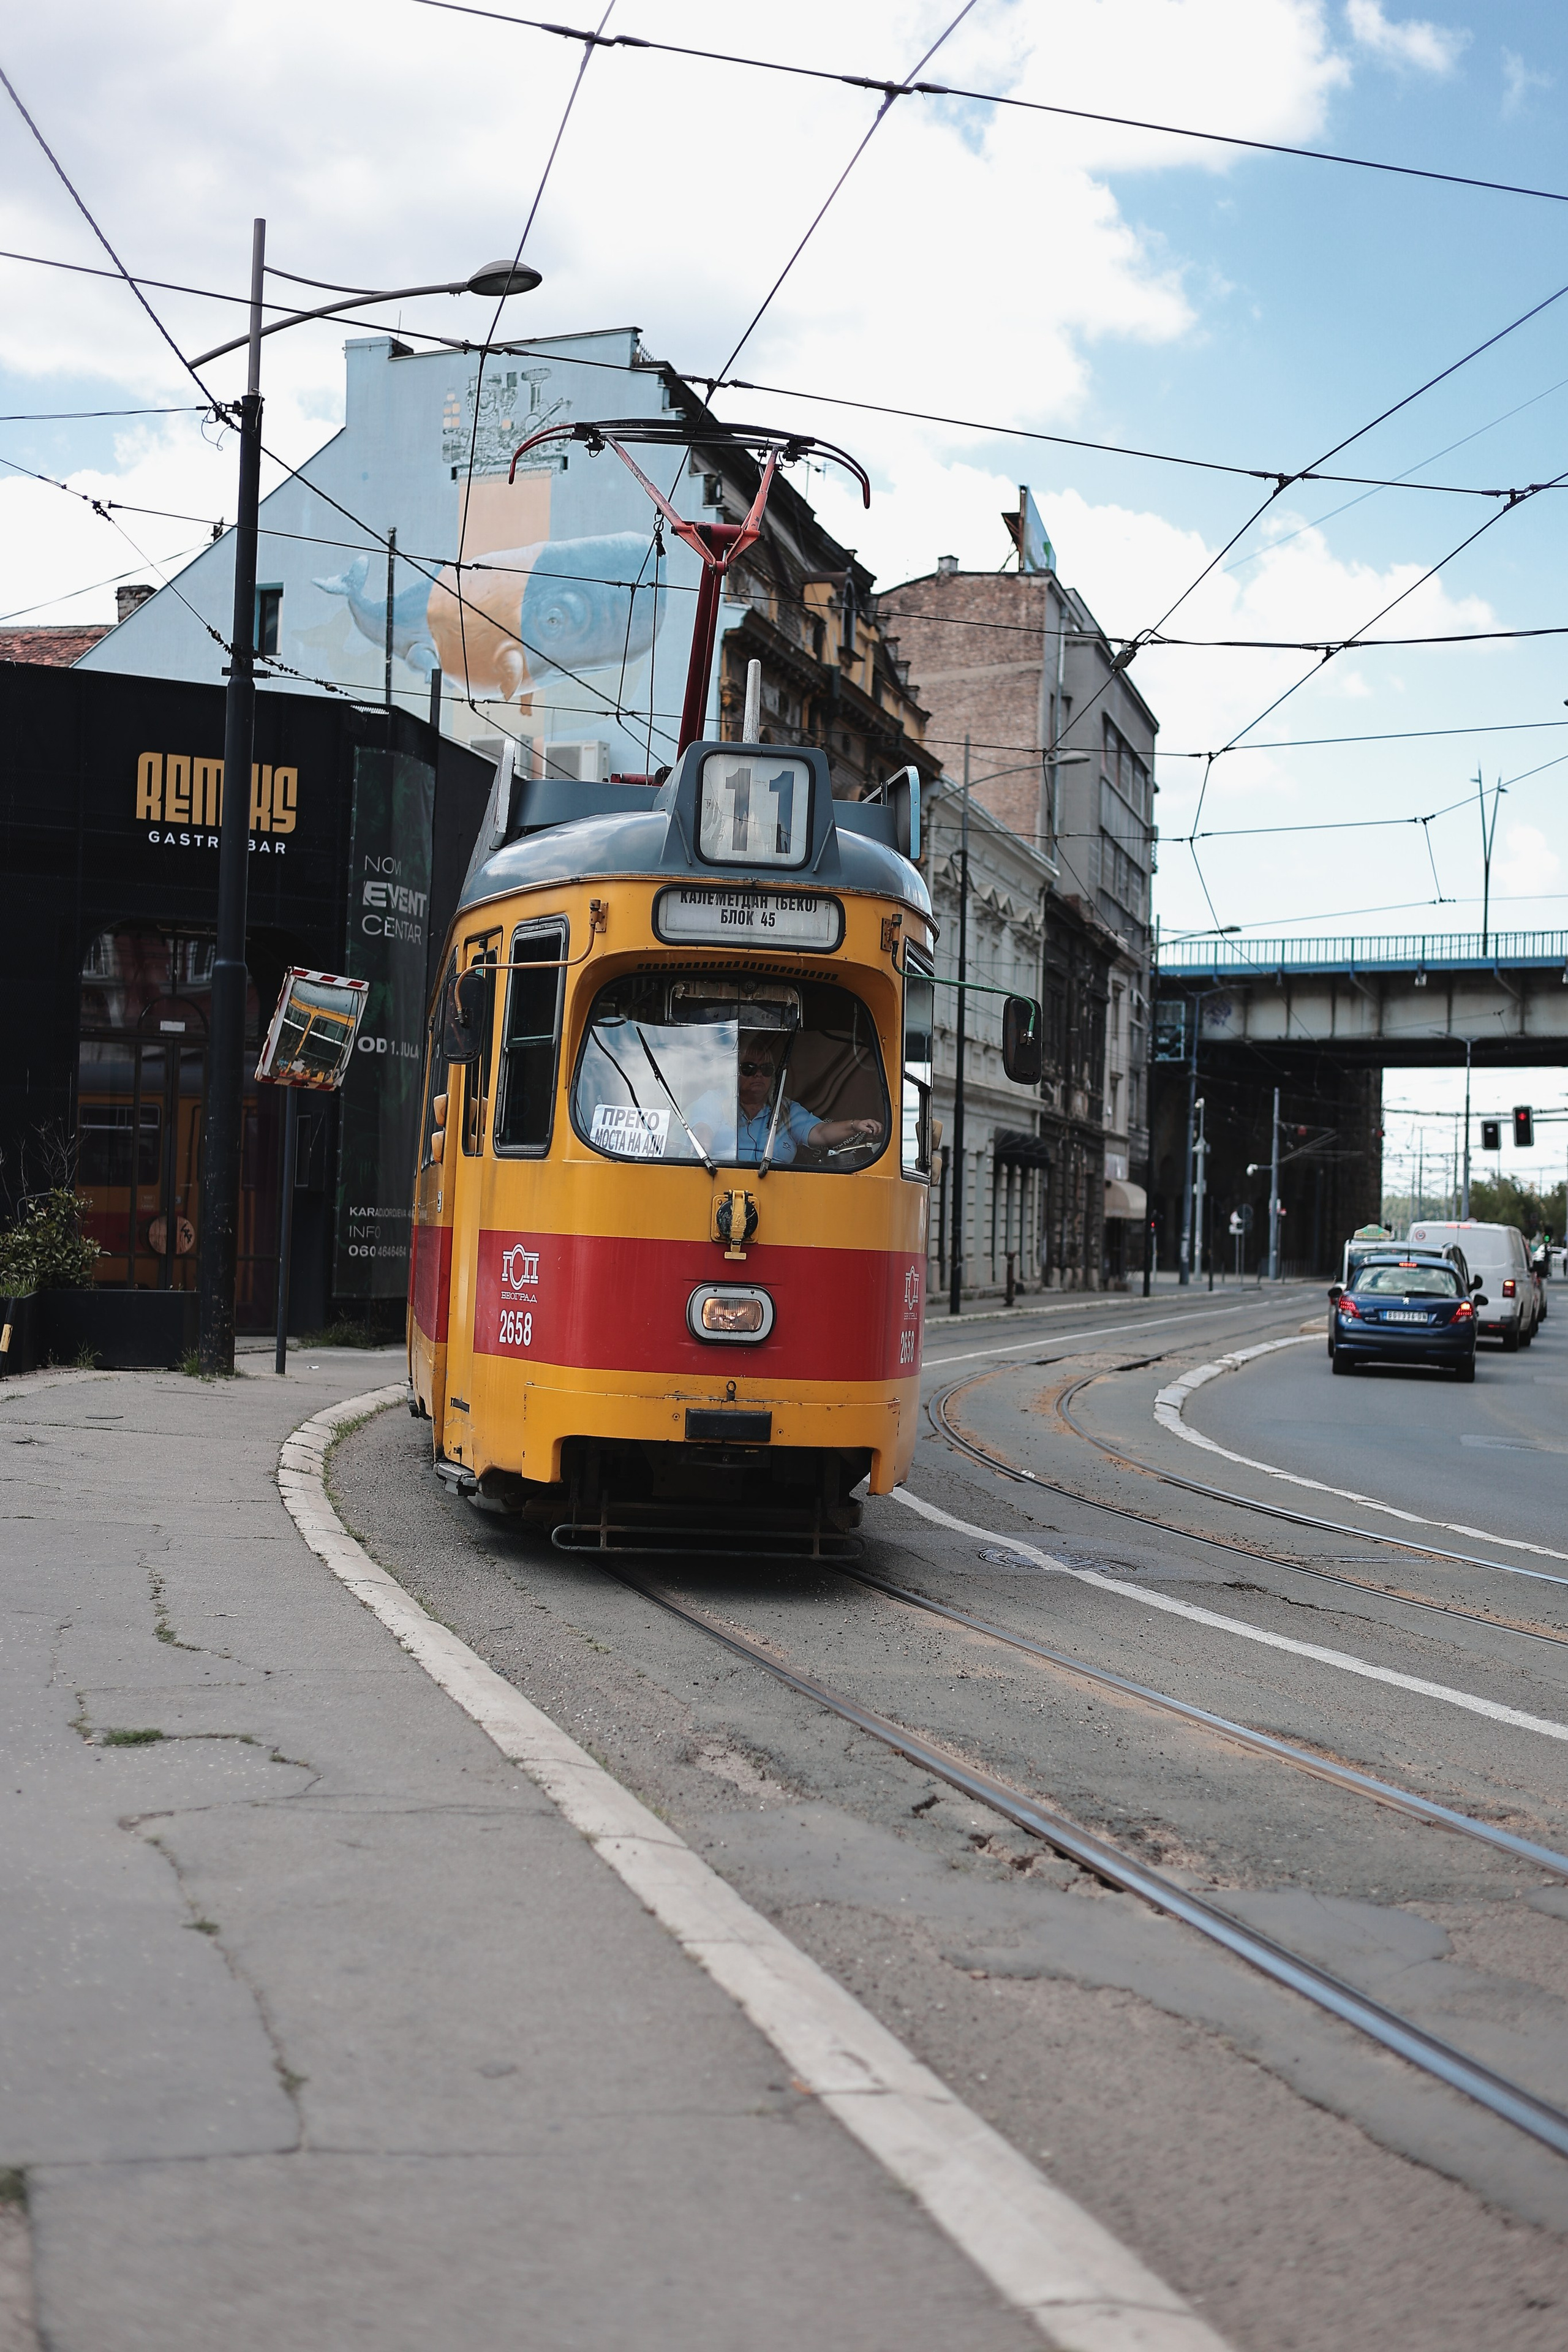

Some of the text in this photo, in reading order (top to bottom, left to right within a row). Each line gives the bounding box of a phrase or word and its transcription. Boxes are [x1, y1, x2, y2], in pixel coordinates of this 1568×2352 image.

[136, 752, 298, 833] REMKS
[725, 767, 795, 853] 11
[148, 831, 219, 848] GASTR
[364, 854, 402, 876] NOVI
[363, 880, 428, 918] EVENT
[361, 914, 421, 945] CENTAR
[720, 909, 776, 927] БЛОК 45
[358, 1036, 387, 1053] OD
[601, 1107, 660, 1131] ПРЕКО
[594, 1128, 665, 1158] МОСТА НА АДИ
[349, 1225, 381, 1238] INFO
[349, 1245, 376, 1257] 060
[499, 1310, 532, 1346] 2658
[900, 1330, 914, 1364] 2658
